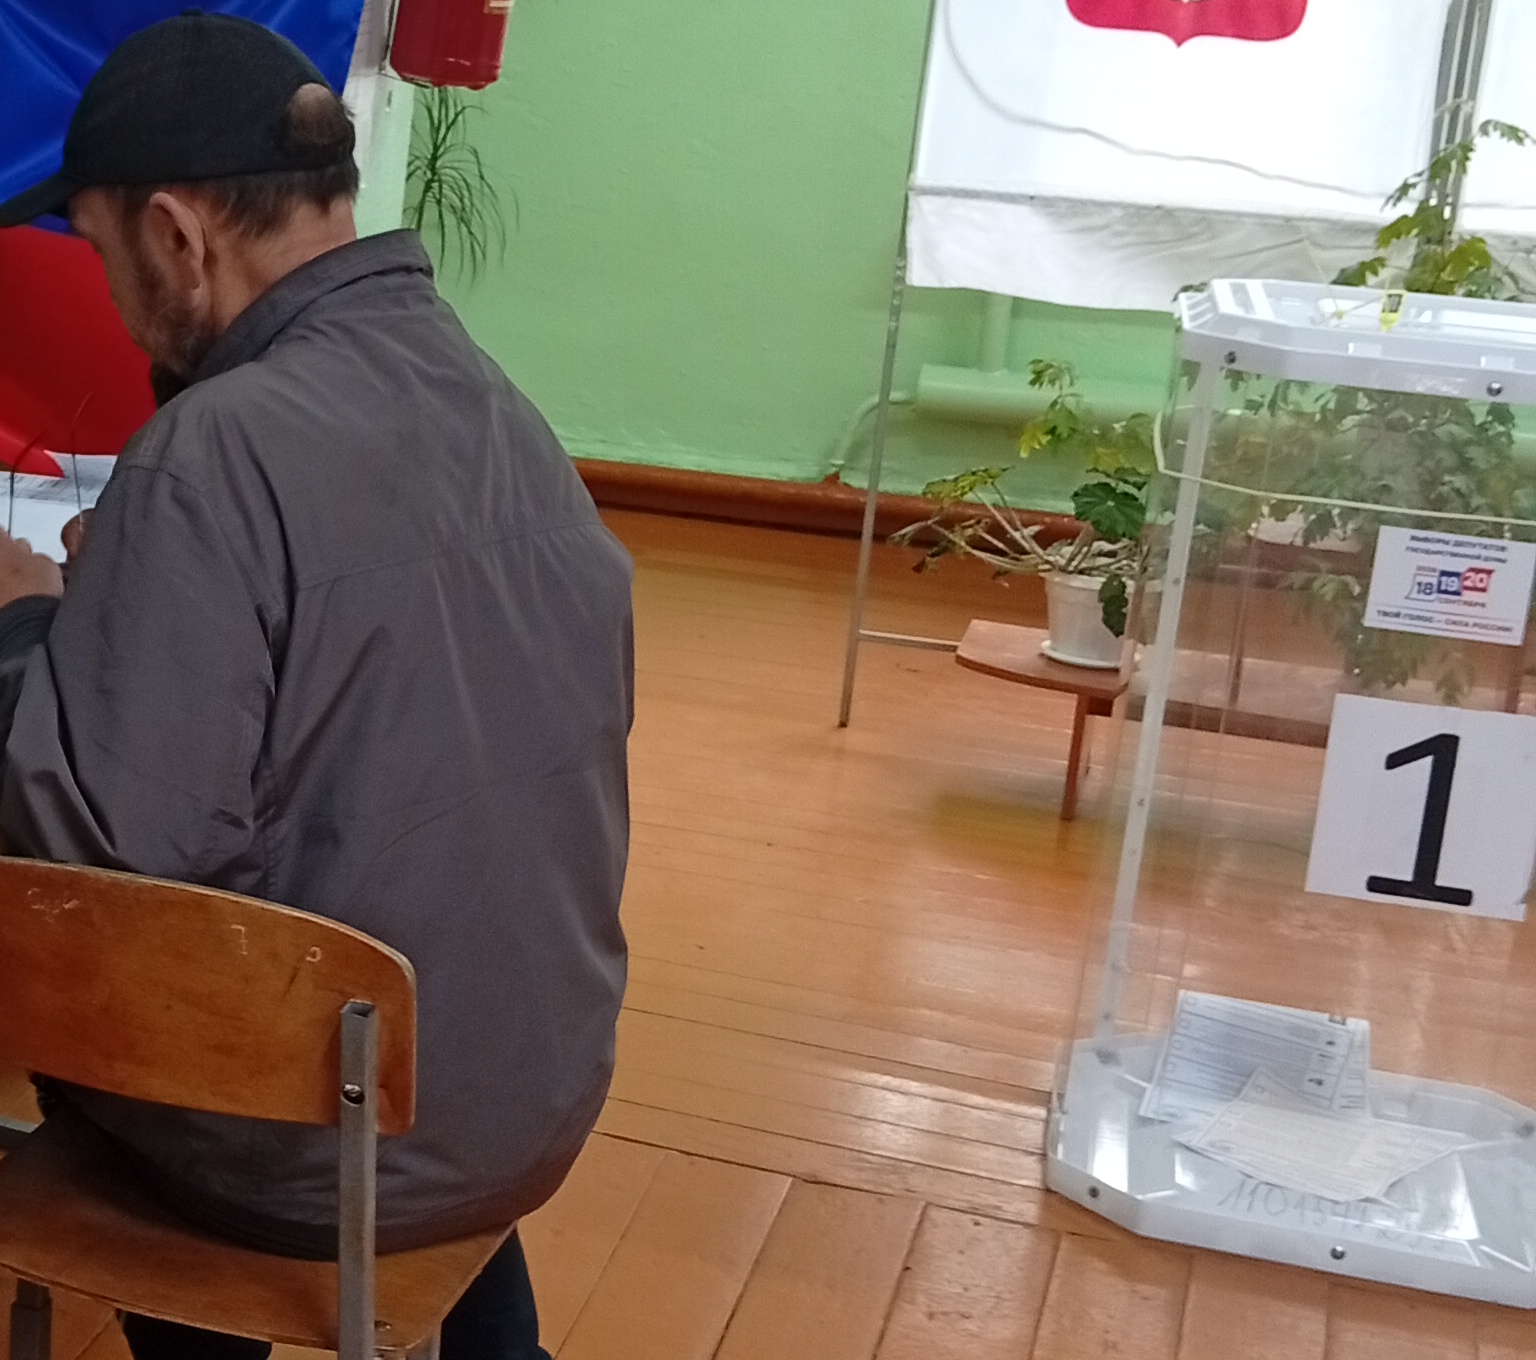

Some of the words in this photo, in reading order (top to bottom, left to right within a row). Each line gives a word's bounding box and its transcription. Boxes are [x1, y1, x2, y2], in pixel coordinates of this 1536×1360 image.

[1410, 534, 1450, 546] ВЫБОРЫ
[1452, 539, 1507, 552] ДЕПУТАТОВ
[1416, 581, 1434, 596] 18
[1439, 576, 1459, 591] 19
[1464, 571, 1488, 588] 20
[1376, 609, 1401, 619] ТВОЙ
[1402, 613, 1434, 623] ГОЛОС
[1444, 618, 1469, 628] СИЛА
[1364, 732, 1474, 908] 1
